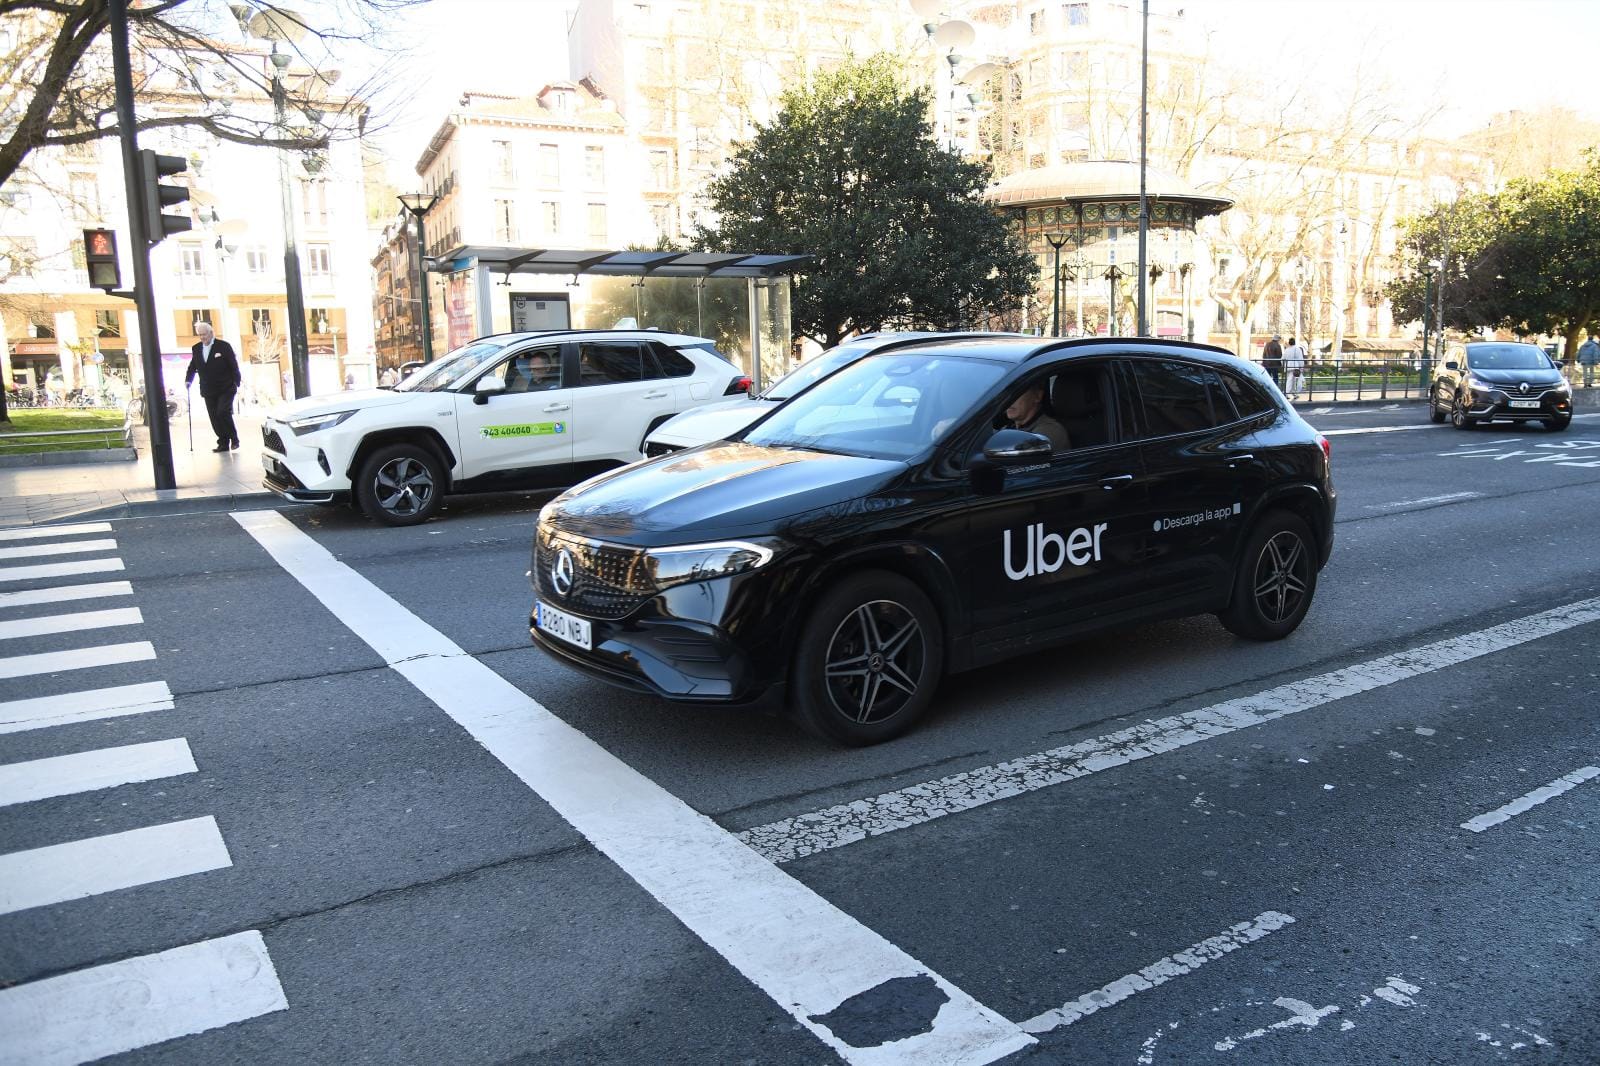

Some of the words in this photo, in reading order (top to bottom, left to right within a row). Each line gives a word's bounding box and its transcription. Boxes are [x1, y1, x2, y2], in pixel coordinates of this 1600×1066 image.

[483, 428, 499, 437] 943
[501, 426, 531, 436] 404040
[1163, 513, 1204, 530] Descarga
[1206, 509, 1213, 521] la
[1214, 507, 1232, 520] app
[1004, 523, 1107, 581] Uber
[542, 608, 566, 636] 8280
[568, 619, 590, 645] NBJ
